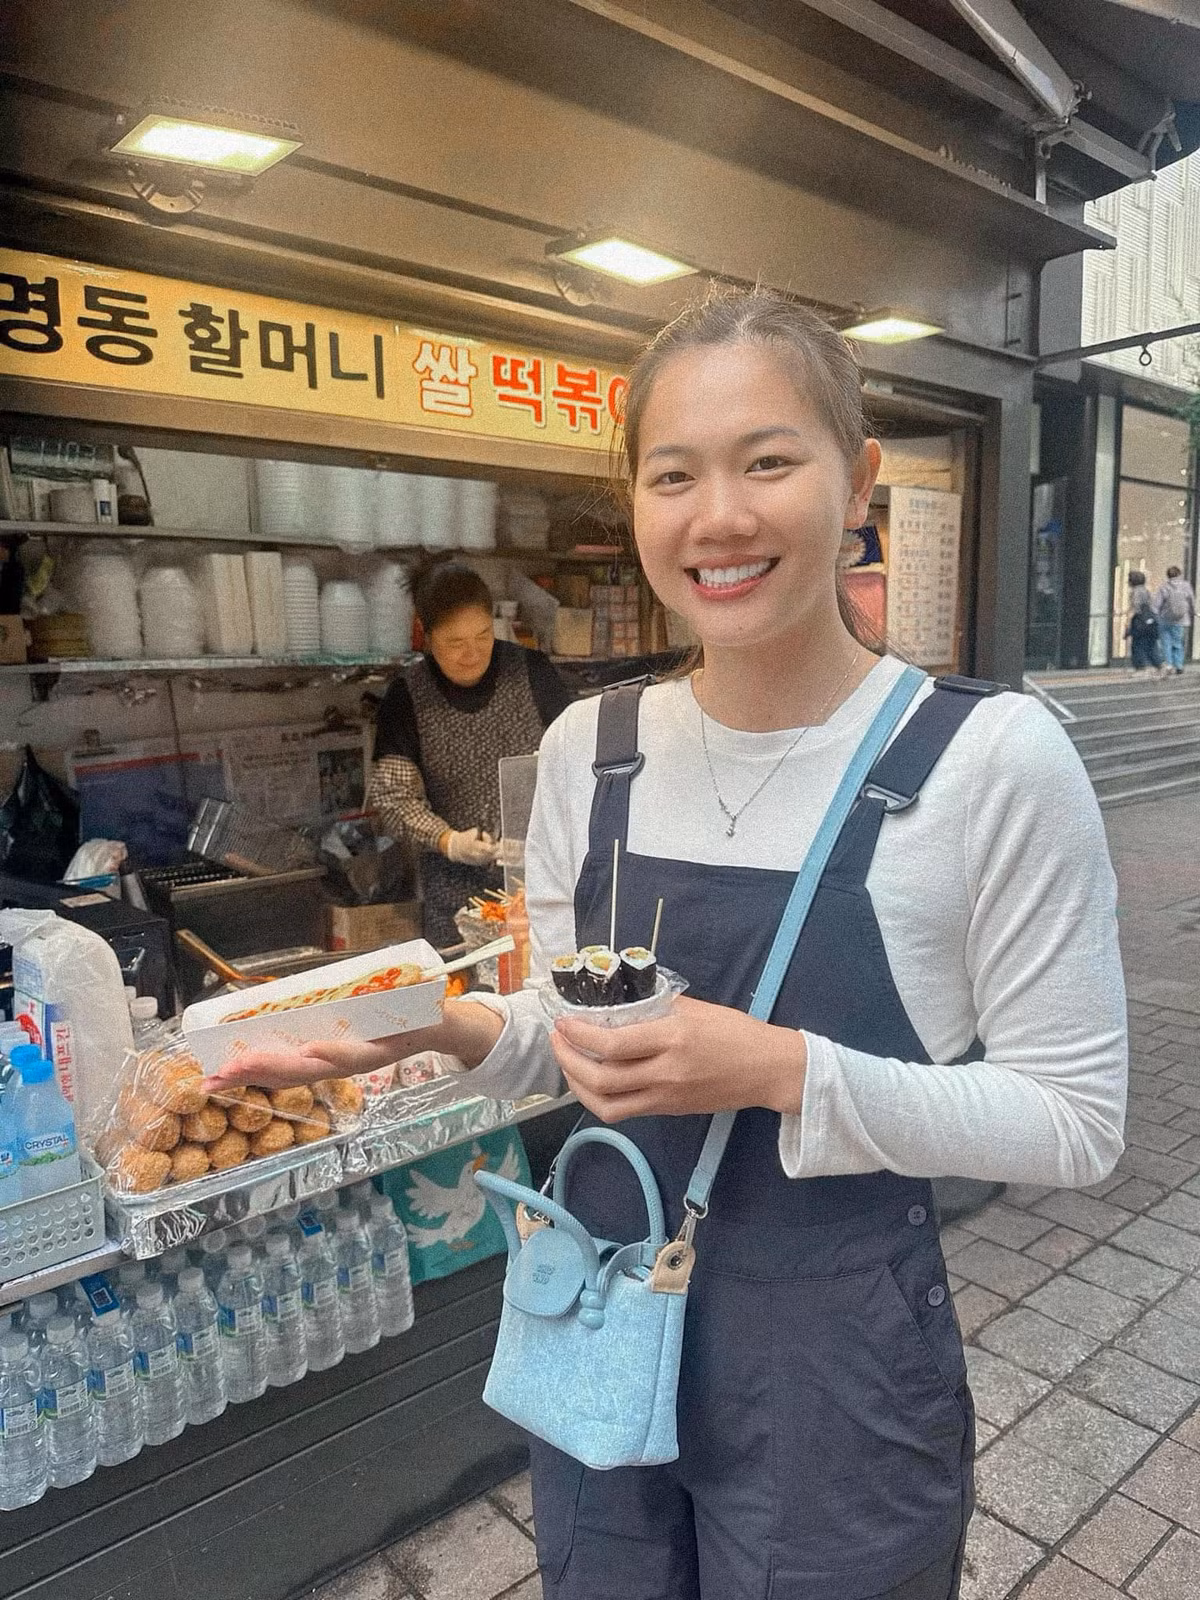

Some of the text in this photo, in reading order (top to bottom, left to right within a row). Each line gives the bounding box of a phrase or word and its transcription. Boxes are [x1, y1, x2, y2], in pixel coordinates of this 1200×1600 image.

[178, 302, 385, 400] 할머니
[412, 341, 478, 417] 쌀
[25, 1134, 69, 1150] CRYSTAL
